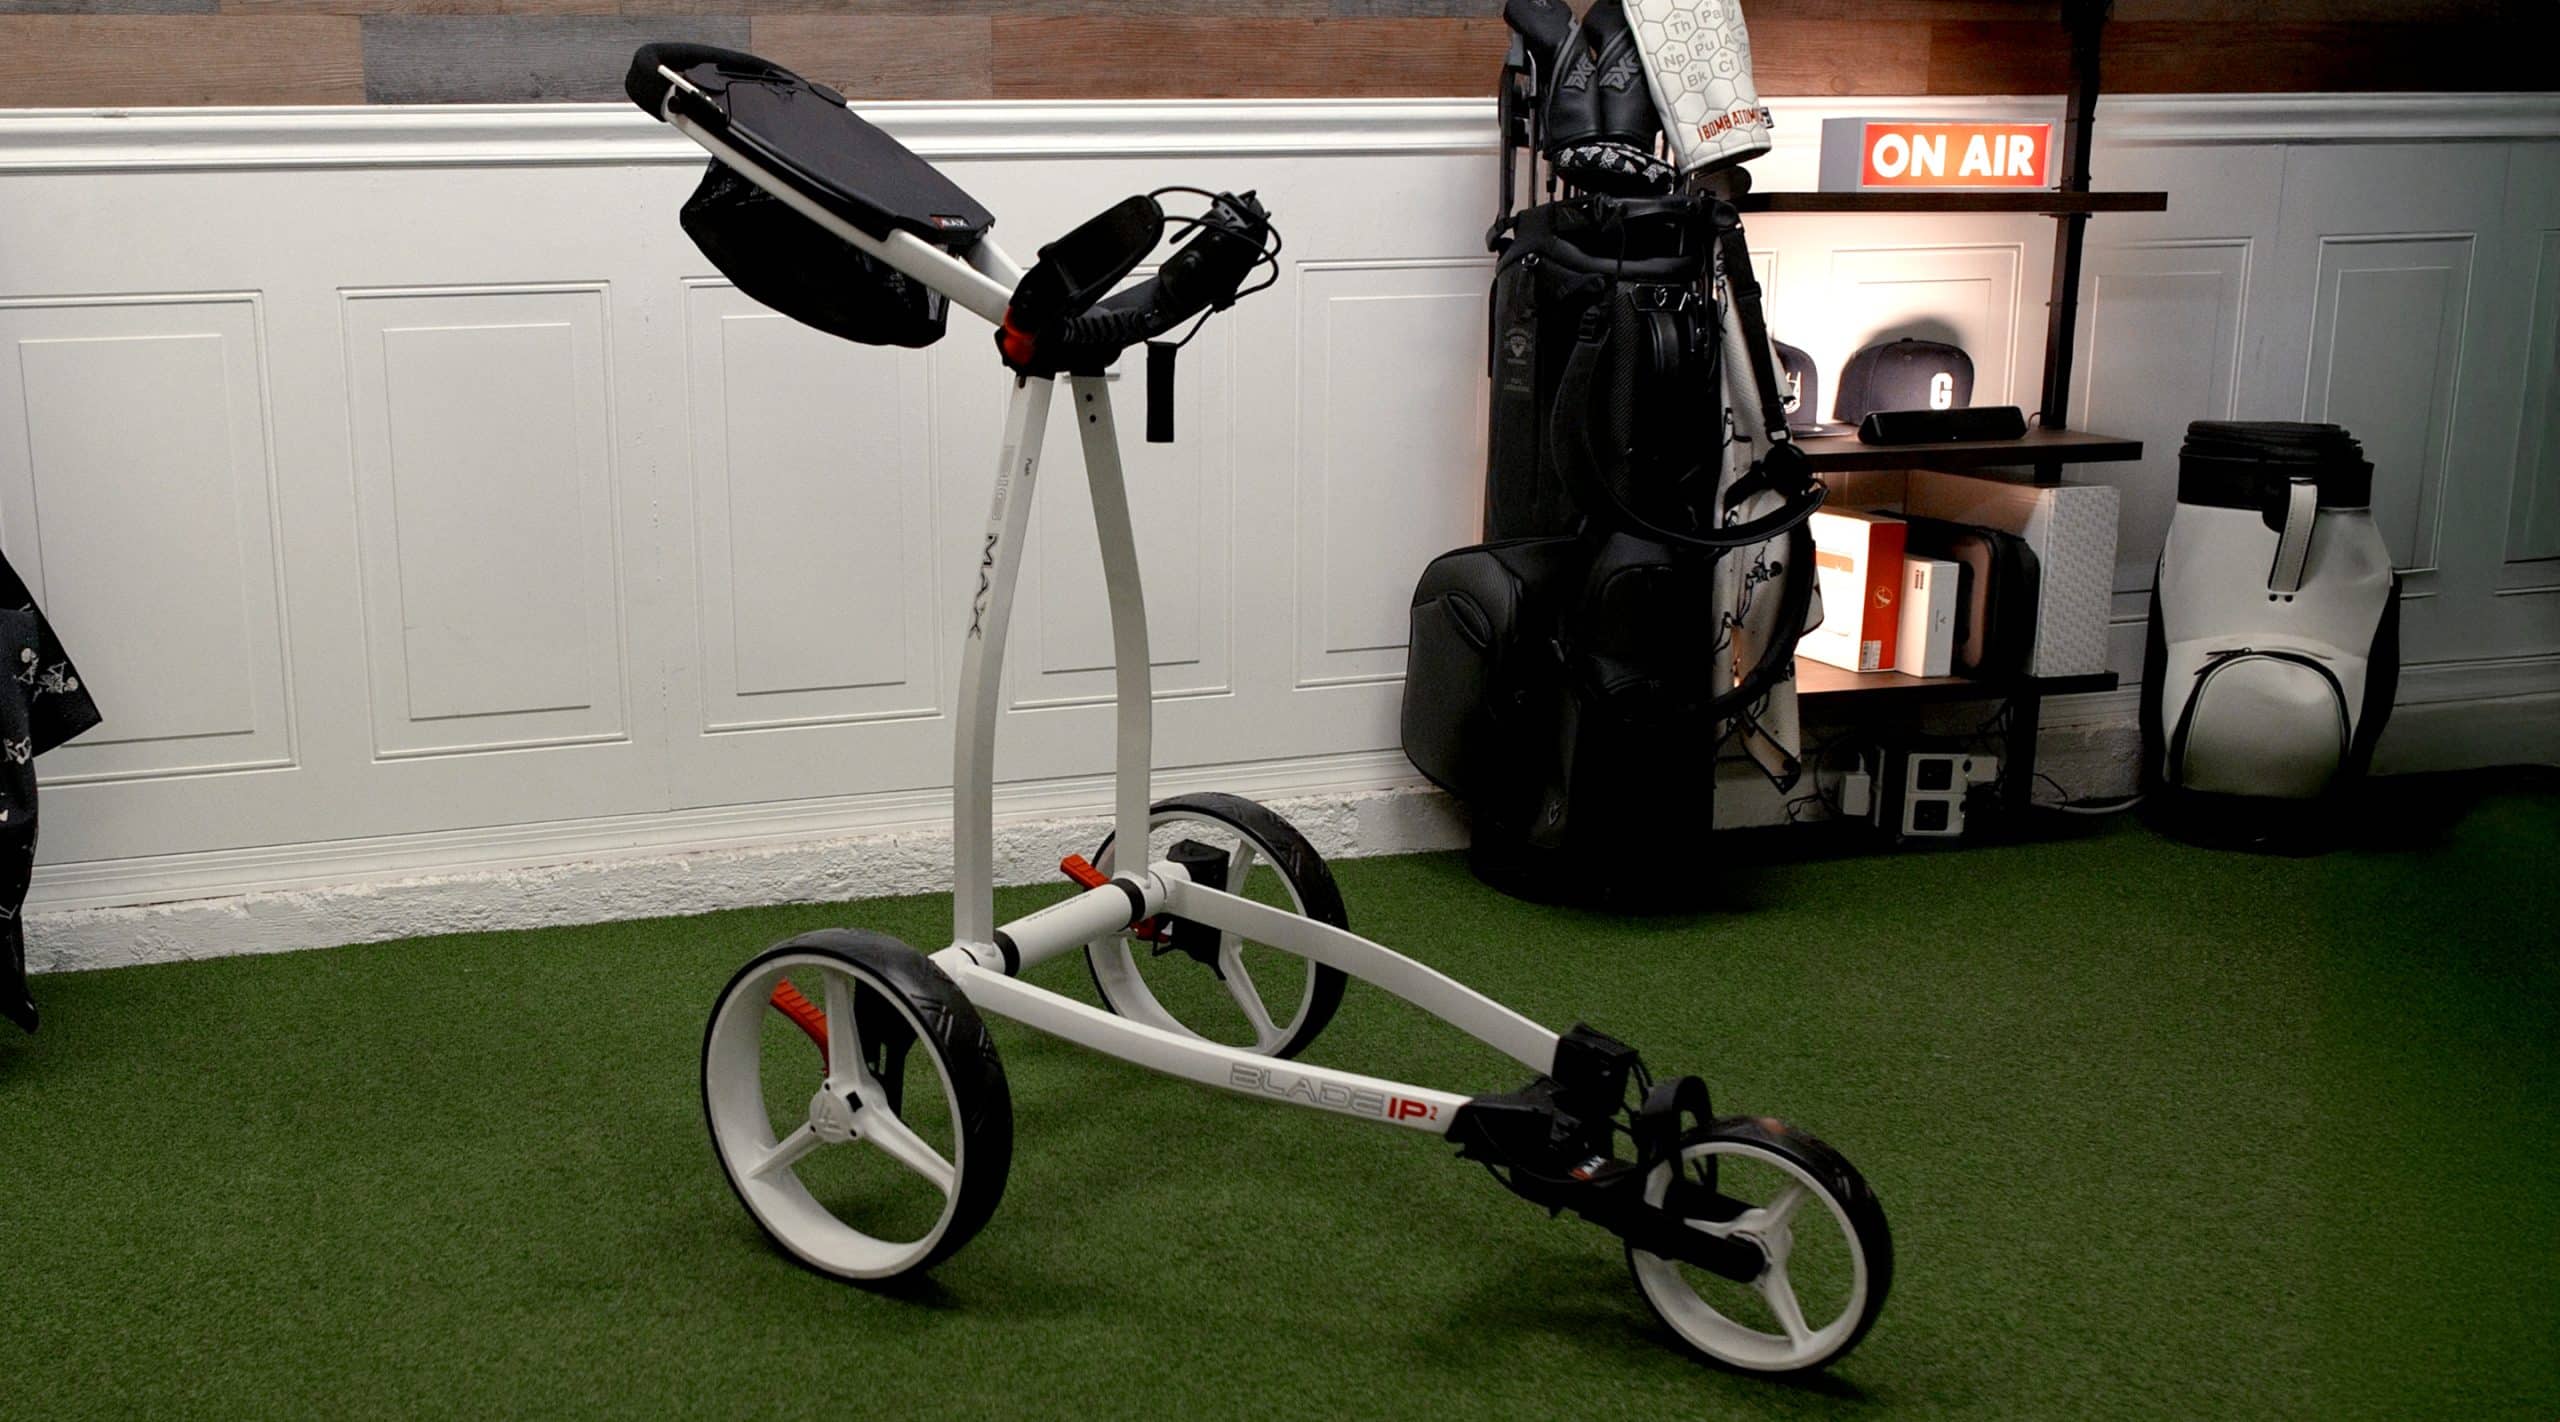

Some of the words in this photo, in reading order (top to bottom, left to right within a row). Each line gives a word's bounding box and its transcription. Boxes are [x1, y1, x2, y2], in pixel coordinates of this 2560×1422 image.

[1670, 20, 1692, 35] Th
[1694, 41, 1715, 56] Pu
[1663, 53, 1685, 68] Np
[1687, 71, 1708, 88] Bk
[1702, 114, 1732, 139] BOMB
[1872, 133, 1946, 178] ON
[1958, 134, 2035, 177] AIR
[1930, 372, 1953, 410] G
[1230, 1062, 1385, 1117] BLADE
